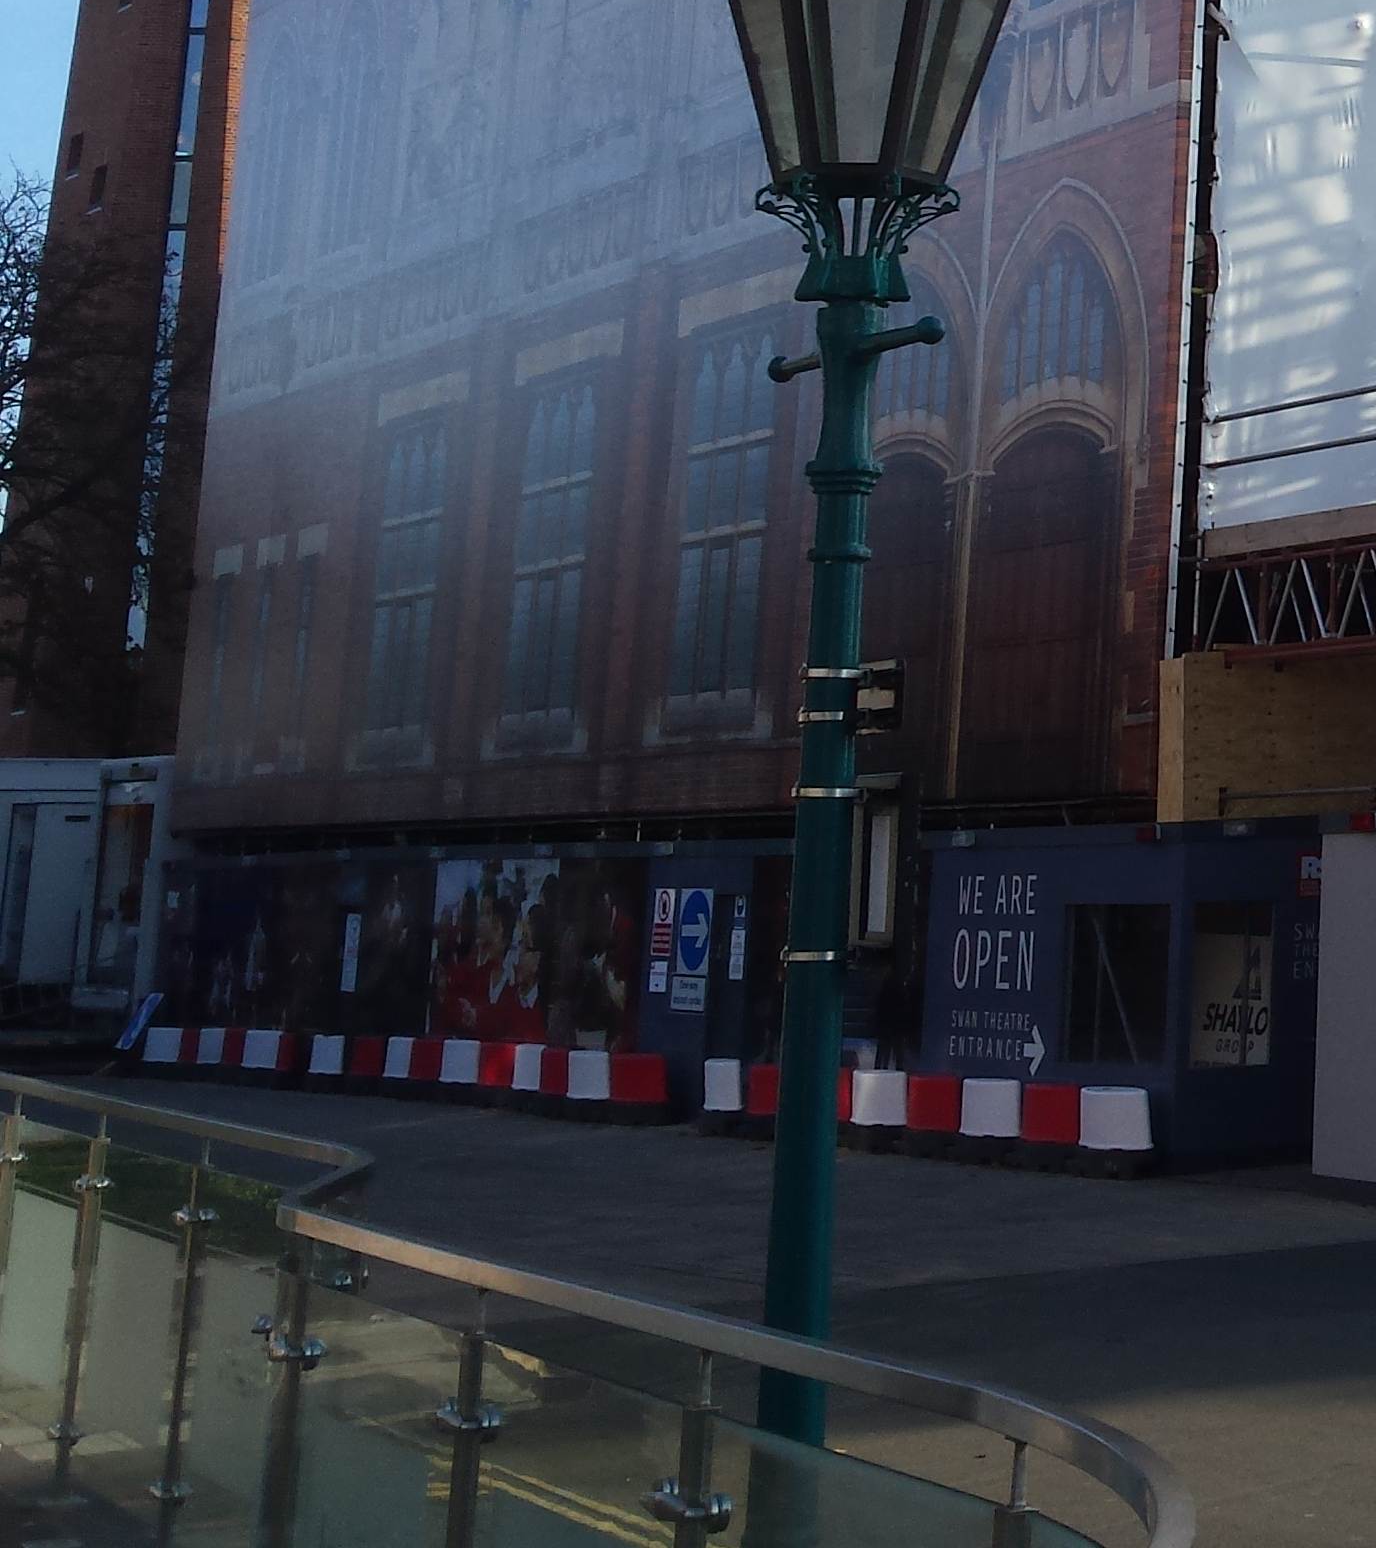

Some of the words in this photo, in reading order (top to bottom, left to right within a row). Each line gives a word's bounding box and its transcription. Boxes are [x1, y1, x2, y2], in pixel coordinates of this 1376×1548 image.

[959, 875, 985, 915] WE
[994, 874, 1038, 915] ARE
[953, 928, 1035, 992] OPEN
[952, 1009, 978, 1029] SWAN
[984, 1011, 1031, 1031] THEATRE
[949, 1035, 1022, 1061] ENTRANCE
